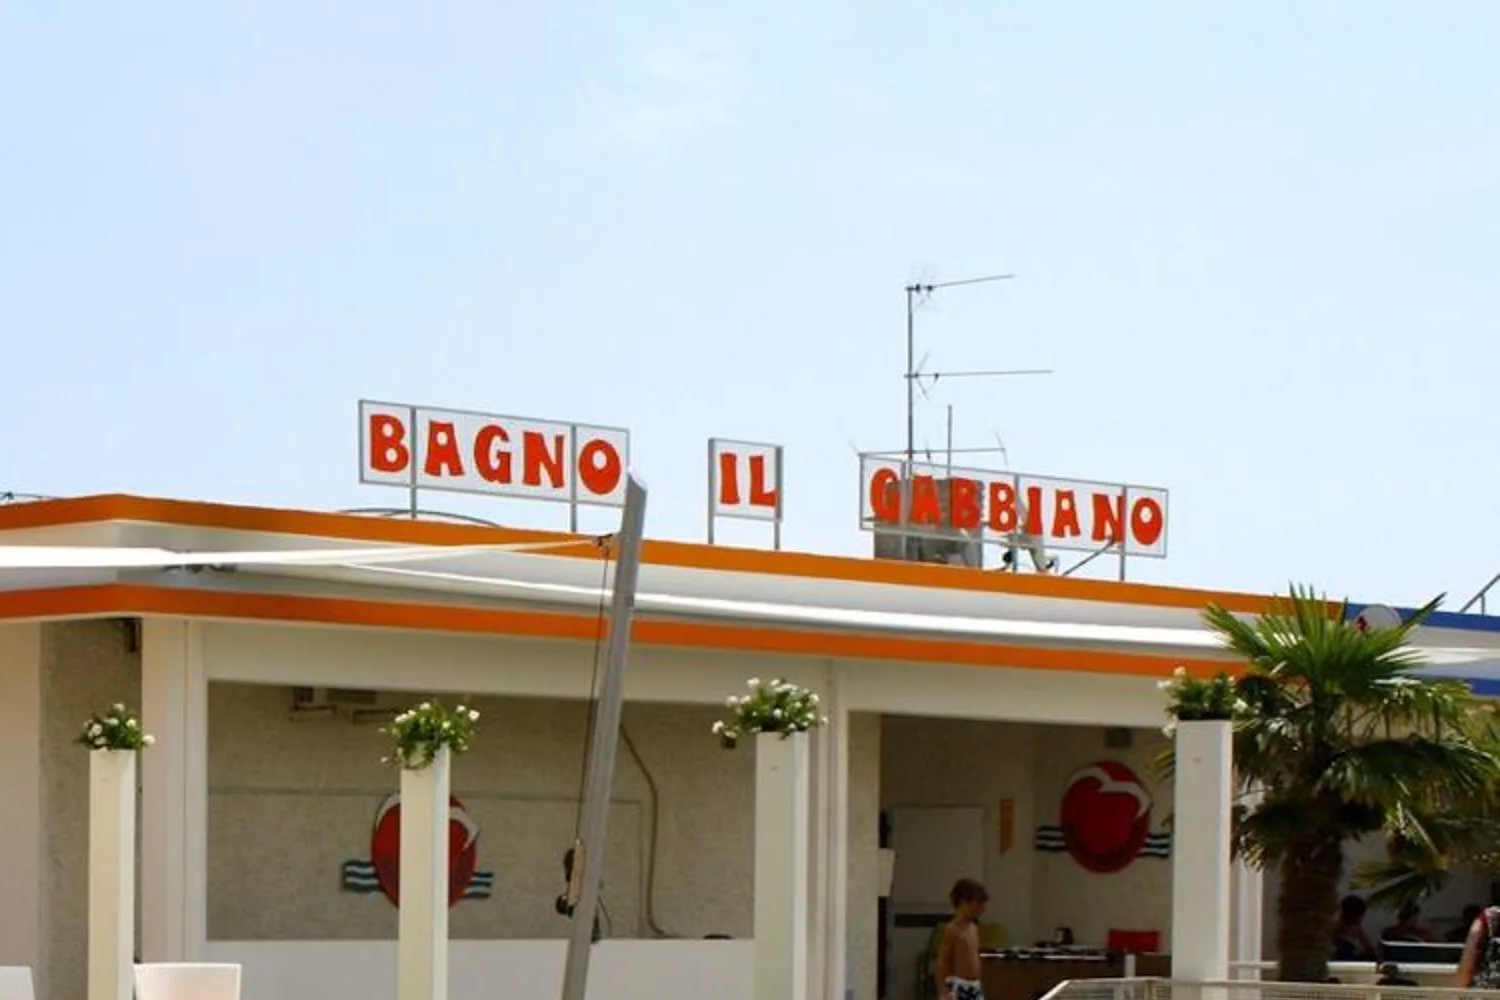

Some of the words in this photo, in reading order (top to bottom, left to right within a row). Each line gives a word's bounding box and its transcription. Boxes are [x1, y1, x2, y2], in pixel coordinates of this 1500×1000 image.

[370, 414, 621, 496] BAGNO
[720, 452, 781, 507] IL
[870, 467, 1163, 545] GABBIANO
